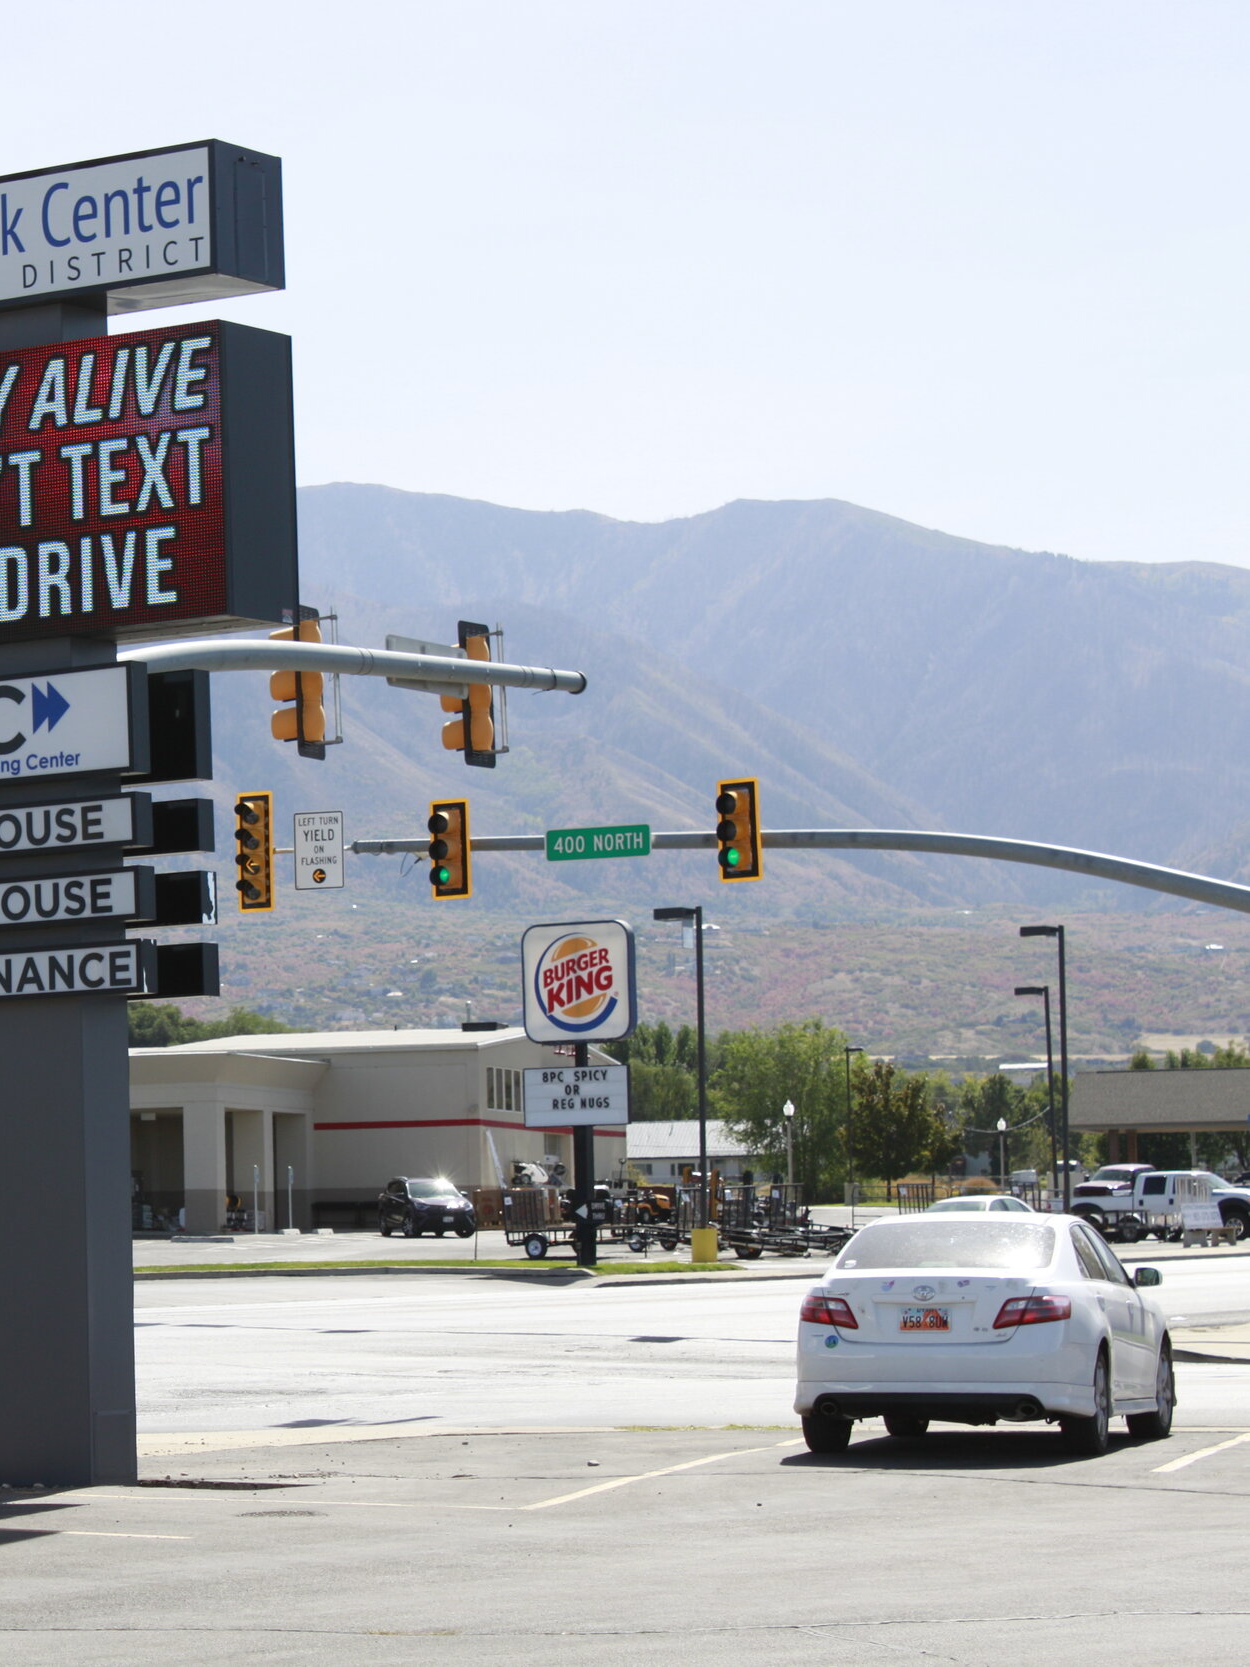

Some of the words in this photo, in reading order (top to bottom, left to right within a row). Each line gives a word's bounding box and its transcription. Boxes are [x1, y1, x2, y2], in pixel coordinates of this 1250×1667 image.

[42, 174, 204, 248] Center
[23, 236, 206, 289] DISTRICT
[29, 336, 212, 430] ALIVE
[60, 426, 210, 520] TEXT
[25, 751, 81, 771] Center
[298, 817, 315, 827] LEFT
[319, 816, 339, 825] TURN
[303, 828, 335, 842] YIELD
[553, 835, 585, 854] 400
[593, 832, 643, 852] NORTH
[313, 845, 325, 854] ON
[301, 855, 338, 866] FLASHING
[542, 947, 610, 989] BURGER
[546, 965, 613, 1015] KING
[542, 1071, 564, 1083] 8PC
[574, 1069, 608, 1082] SPICY
[564, 1084, 580, 1096] OR
[552, 1098, 575, 1111] REG
[580, 1096, 610, 1109] NUGS
